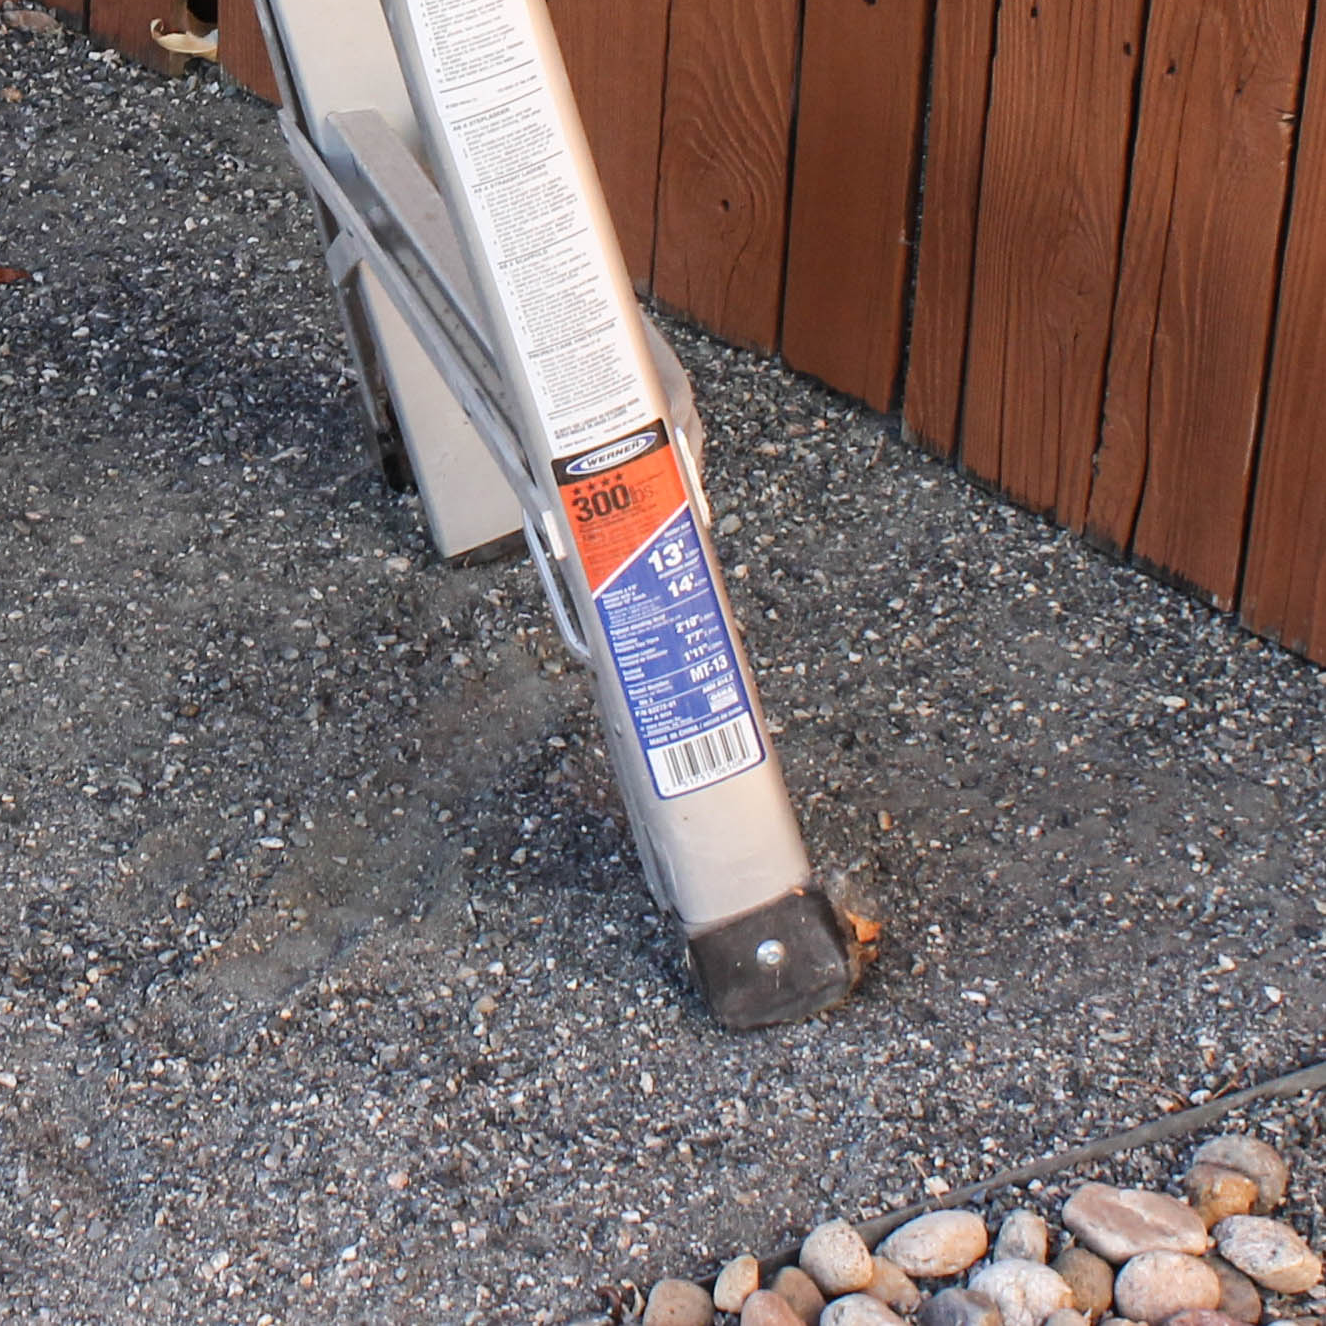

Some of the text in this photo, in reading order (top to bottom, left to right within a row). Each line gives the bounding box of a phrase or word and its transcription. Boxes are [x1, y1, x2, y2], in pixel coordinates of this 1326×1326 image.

[588, 442, 640, 467] WERNER
[572, 483, 632, 522] 300
[648, 538, 684, 572] 13'
[668, 572, 694, 597] 14'
[690, 654, 728, 683] MT-13
